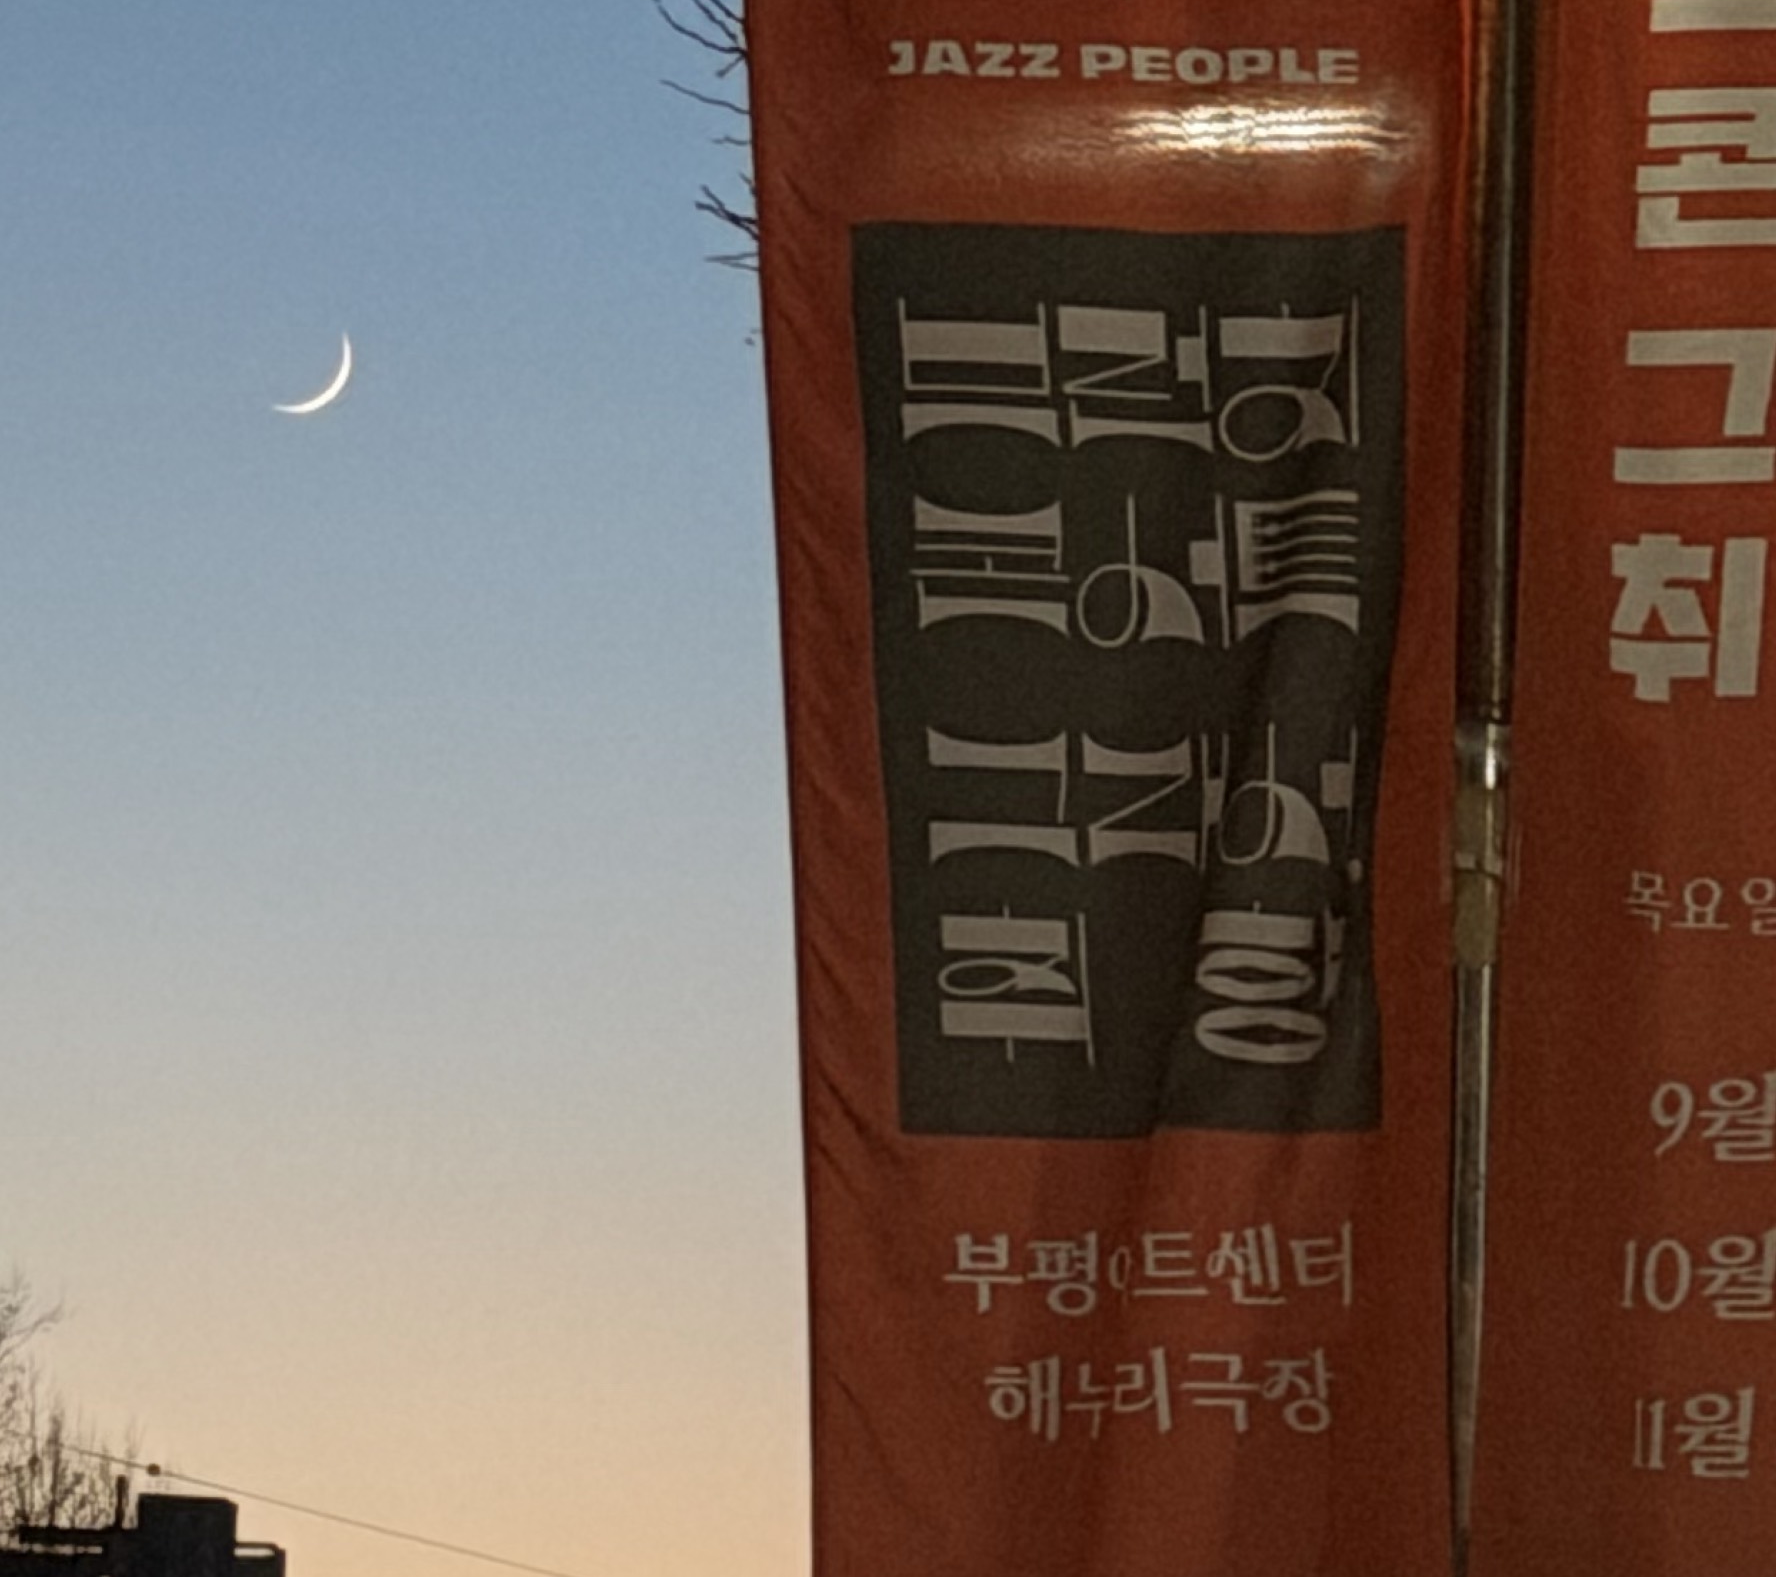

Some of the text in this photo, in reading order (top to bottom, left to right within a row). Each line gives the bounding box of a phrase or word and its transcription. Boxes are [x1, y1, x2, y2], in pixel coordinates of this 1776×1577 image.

[887, 39, 1361, 85] JAZZ PEOPLE
[1649, 1070, 1776, 1163] 9월
[1621, 1227, 1776, 1321] 10월
[983, 1346, 1336, 1442] 해누리극장
